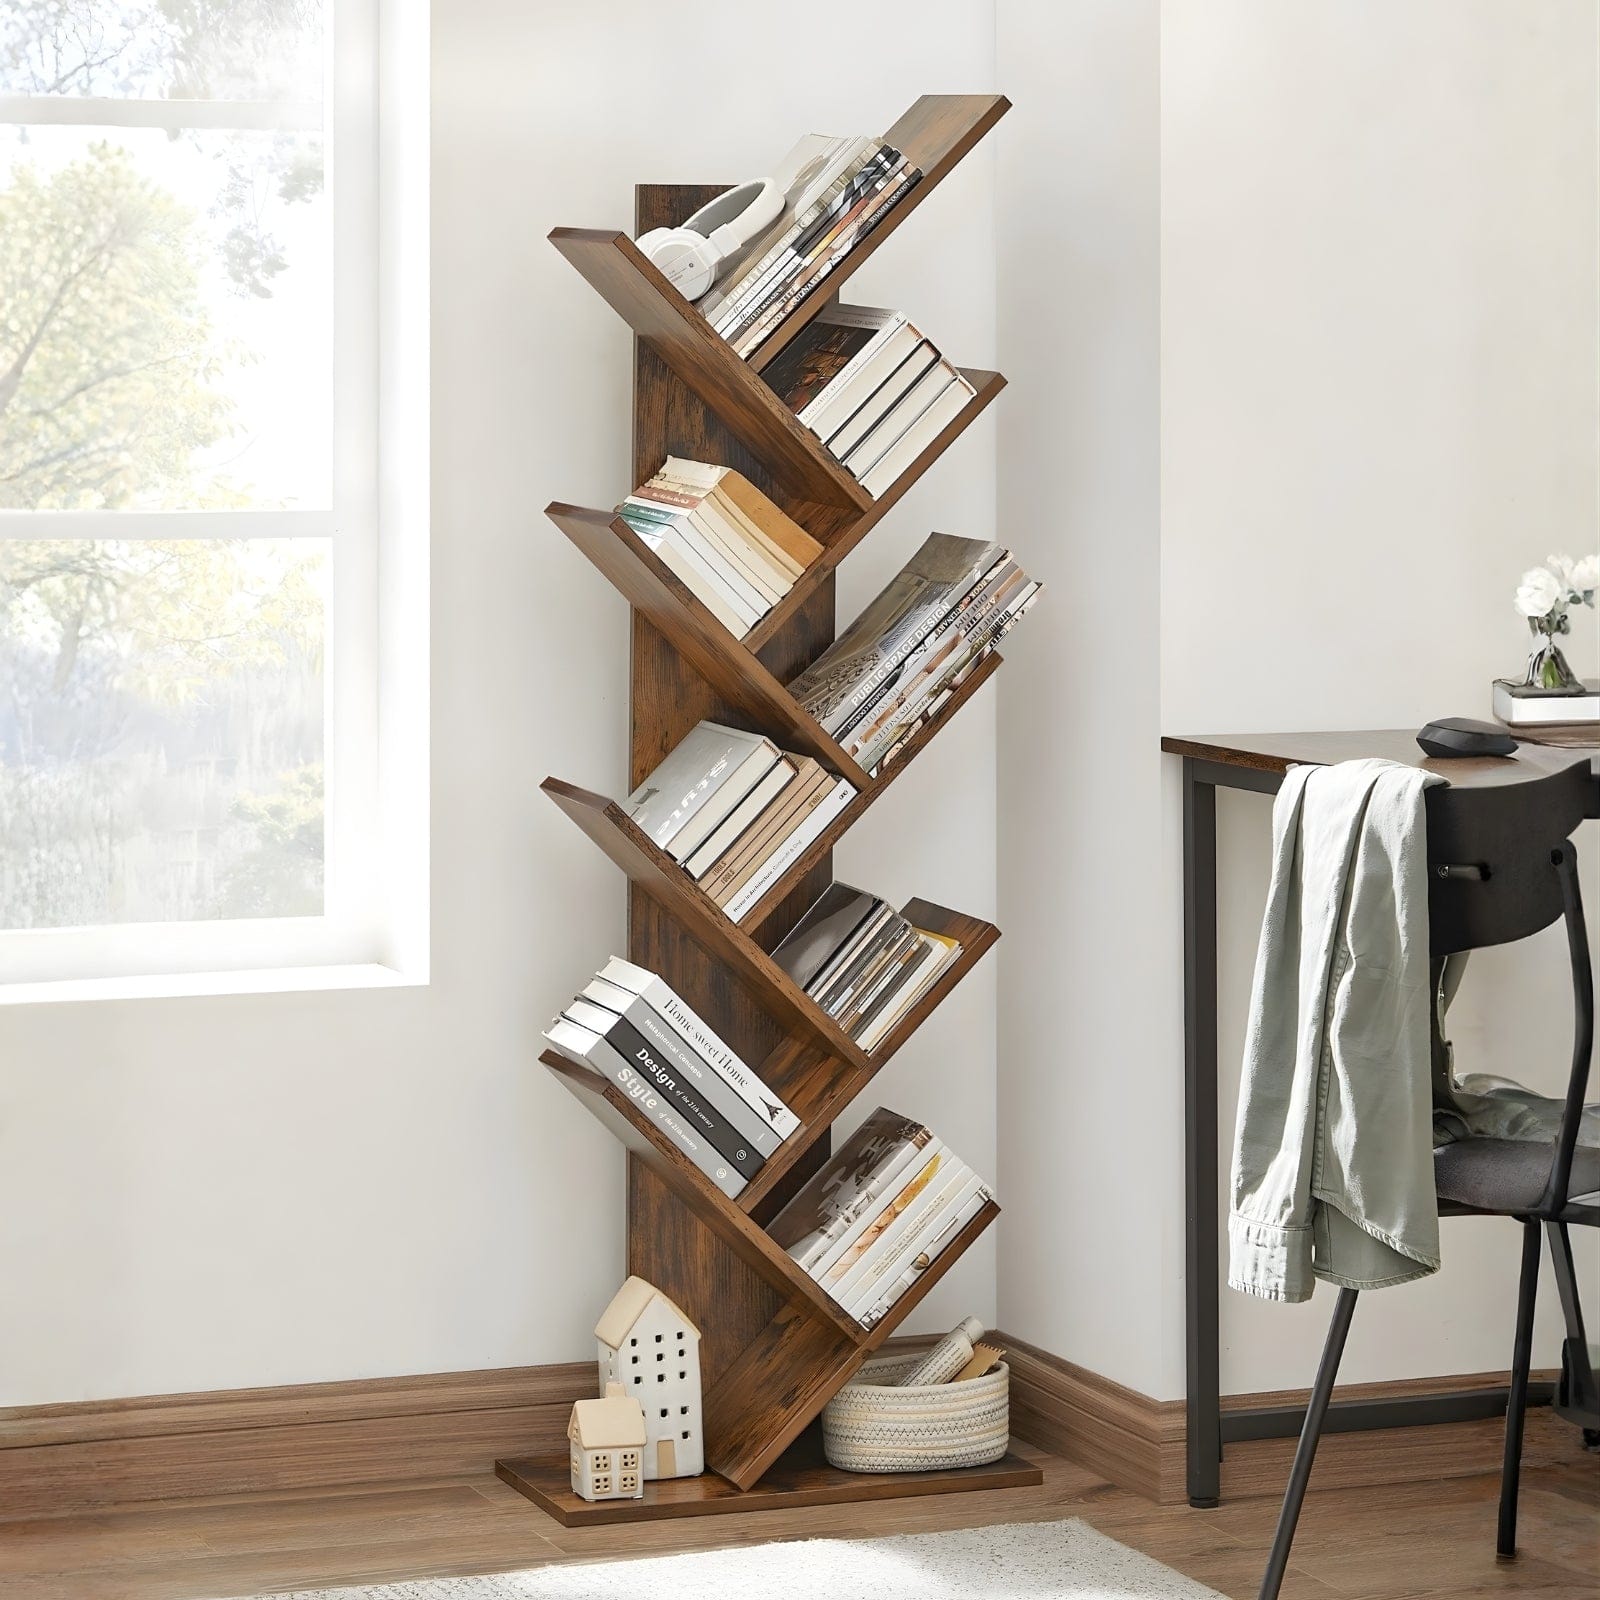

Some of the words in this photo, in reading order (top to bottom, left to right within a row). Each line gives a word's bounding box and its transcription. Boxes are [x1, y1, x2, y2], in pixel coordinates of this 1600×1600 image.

[935, 602, 965, 634] CULINARY
[953, 593, 988, 629] DREAM
[966, 607, 1000, 643] DREAM
[850, 668, 887, 706] PUBLIC
[883, 636, 917, 671] SPACE
[913, 600, 951, 640] DESIGN
[643, 1018, 679, 1054] Metaphorical
[677, 1052, 704, 1079] Concepts
[662, 999, 694, 1033] Home
[692, 1031, 720, 1058] sweet
[717, 1054, 748, 1088] Home
[616, 1066, 658, 1109] Style
[657, 1110, 667, 1119] of
[664, 1115, 674, 1125] the
[678, 1131, 698, 1151] century
[635, 1047, 678, 1090] Design
[674, 1088, 683, 1098] of
[680, 1094, 690, 1103] the
[696, 1110, 715, 1129] century
